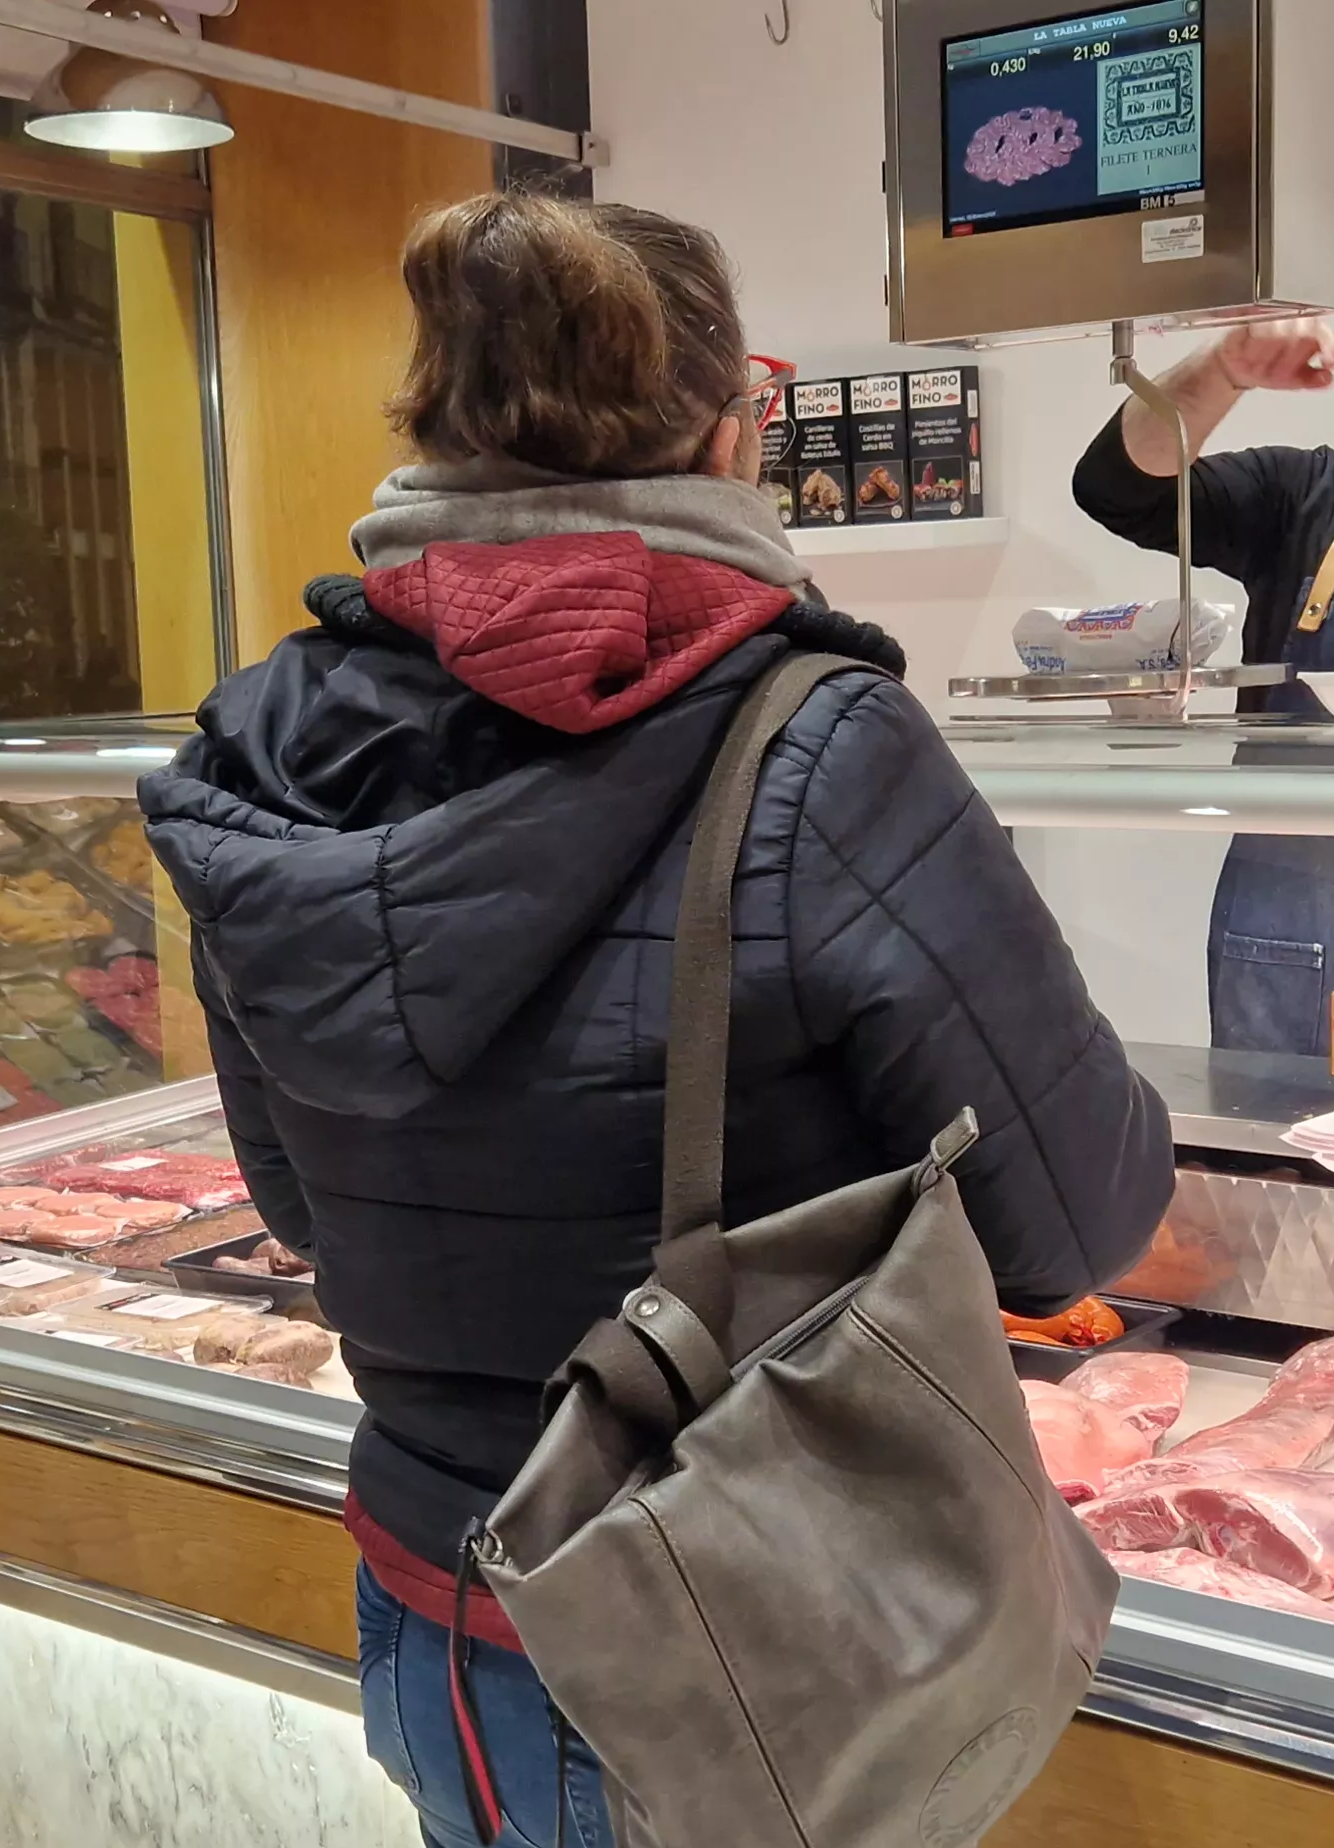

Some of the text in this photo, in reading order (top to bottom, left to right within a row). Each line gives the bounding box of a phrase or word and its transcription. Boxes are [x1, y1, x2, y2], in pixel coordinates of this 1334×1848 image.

[1034, 16, 1127, 41] LA TABLA NUEVA
[1168, 24, 1199, 44] 9,42
[1073, 41, 1110, 61] 21,90
[990, 57, 1026, 77] 0,430
[1101, 143, 1197, 168] FILETE TERNERA
[853, 380, 897, 396] MORRO
[912, 375, 957, 391] MORRO
[797, 386, 839, 402] MORRO
[912, 392, 941, 405] FINO
[798, 403, 824, 415] FINO
[854, 397, 882, 410] FINO
